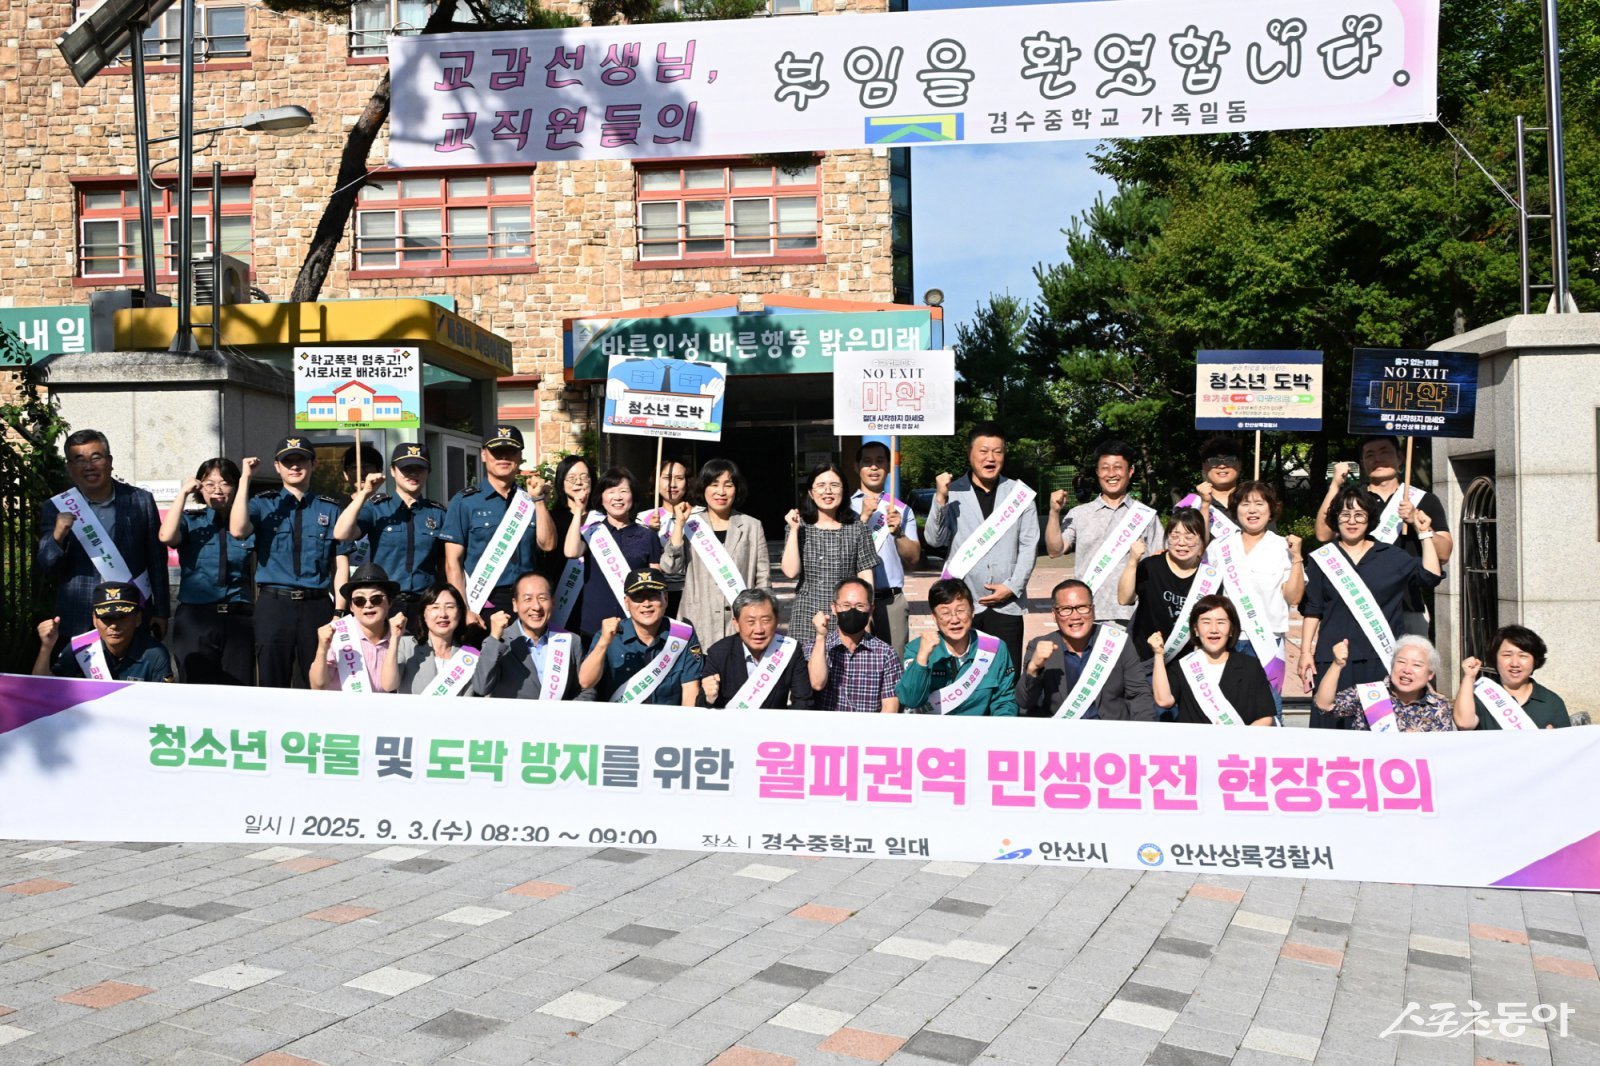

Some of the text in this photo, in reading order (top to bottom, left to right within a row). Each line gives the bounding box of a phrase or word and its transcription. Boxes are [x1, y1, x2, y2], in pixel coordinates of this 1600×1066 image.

[434, 40, 718, 91] 교감선생님,
[774, 14, 1410, 111] 부임을 환영합니다.
[434, 101, 698, 153] 교직원들의
[988, 100, 1248, 134] 경수중학교 가족일동
[19, 317, 85, 352] 내일
[601, 326, 921, 360] 바른인성 바른행동 밝은미래
[305, 366, 407, 378] 서로서로 배려하고!
[311, 354, 401, 366] 학교폭력 멈추고!
[863, 368, 925, 379] NO EXIT
[1209, 372, 1314, 391] 청소년 도박
[1384, 366, 1449, 380] NO EXIT
[862, 381, 925, 411] 마약
[1381, 381, 1448, 411] 마약
[628, 401, 704, 419] 청소년 도박
[877, 414, 904, 422] 시작하지
[905, 414, 924, 422] 마세요
[1395, 414, 1424, 423] 시작하지
[1424, 415, 1446, 424] 마세요
[514, 500, 529, 521] 마약은
[995, 506, 1015, 528] OUT!
[503, 519, 520, 542] 미래를
[1110, 529, 1131, 554] OUT!
[701, 539, 721, 564] OUT!
[1326, 557, 1345, 576] 마약은
[1226, 565, 1244, 595] OUT!
[335, 620, 350, 642] 마약은
[342, 644, 357, 678] OUT!
[551, 649, 564, 673] 마약은
[1099, 638, 1117, 664] 마약은
[444, 665, 465, 686] 마약은
[651, 654, 672, 677] 마약은
[747, 648, 784, 701] 마약은 OUT!
[1087, 663, 1105, 687] 미래를
[1199, 682, 1220, 711] OUT!
[149, 723, 1434, 813] 청소년 약물 및 도박 방지를 위한 월피권역 민생안전 현장회의
[244, 814, 282, 836] 일시
[302, 815, 366, 839] 2025.
[376, 819, 397, 840] 9.
[408, 819, 473, 842] 3.(수)
[481, 823, 550, 843] 08:30
[588, 828, 657, 845] 09:00
[702, 834, 738, 848] 장소
[761, 833, 876, 854] 경수중학교
[885, 837, 930, 856] 일대
[1038, 841, 1109, 863] 안산시
[1170, 843, 1334, 870] 안산상록경찰서
